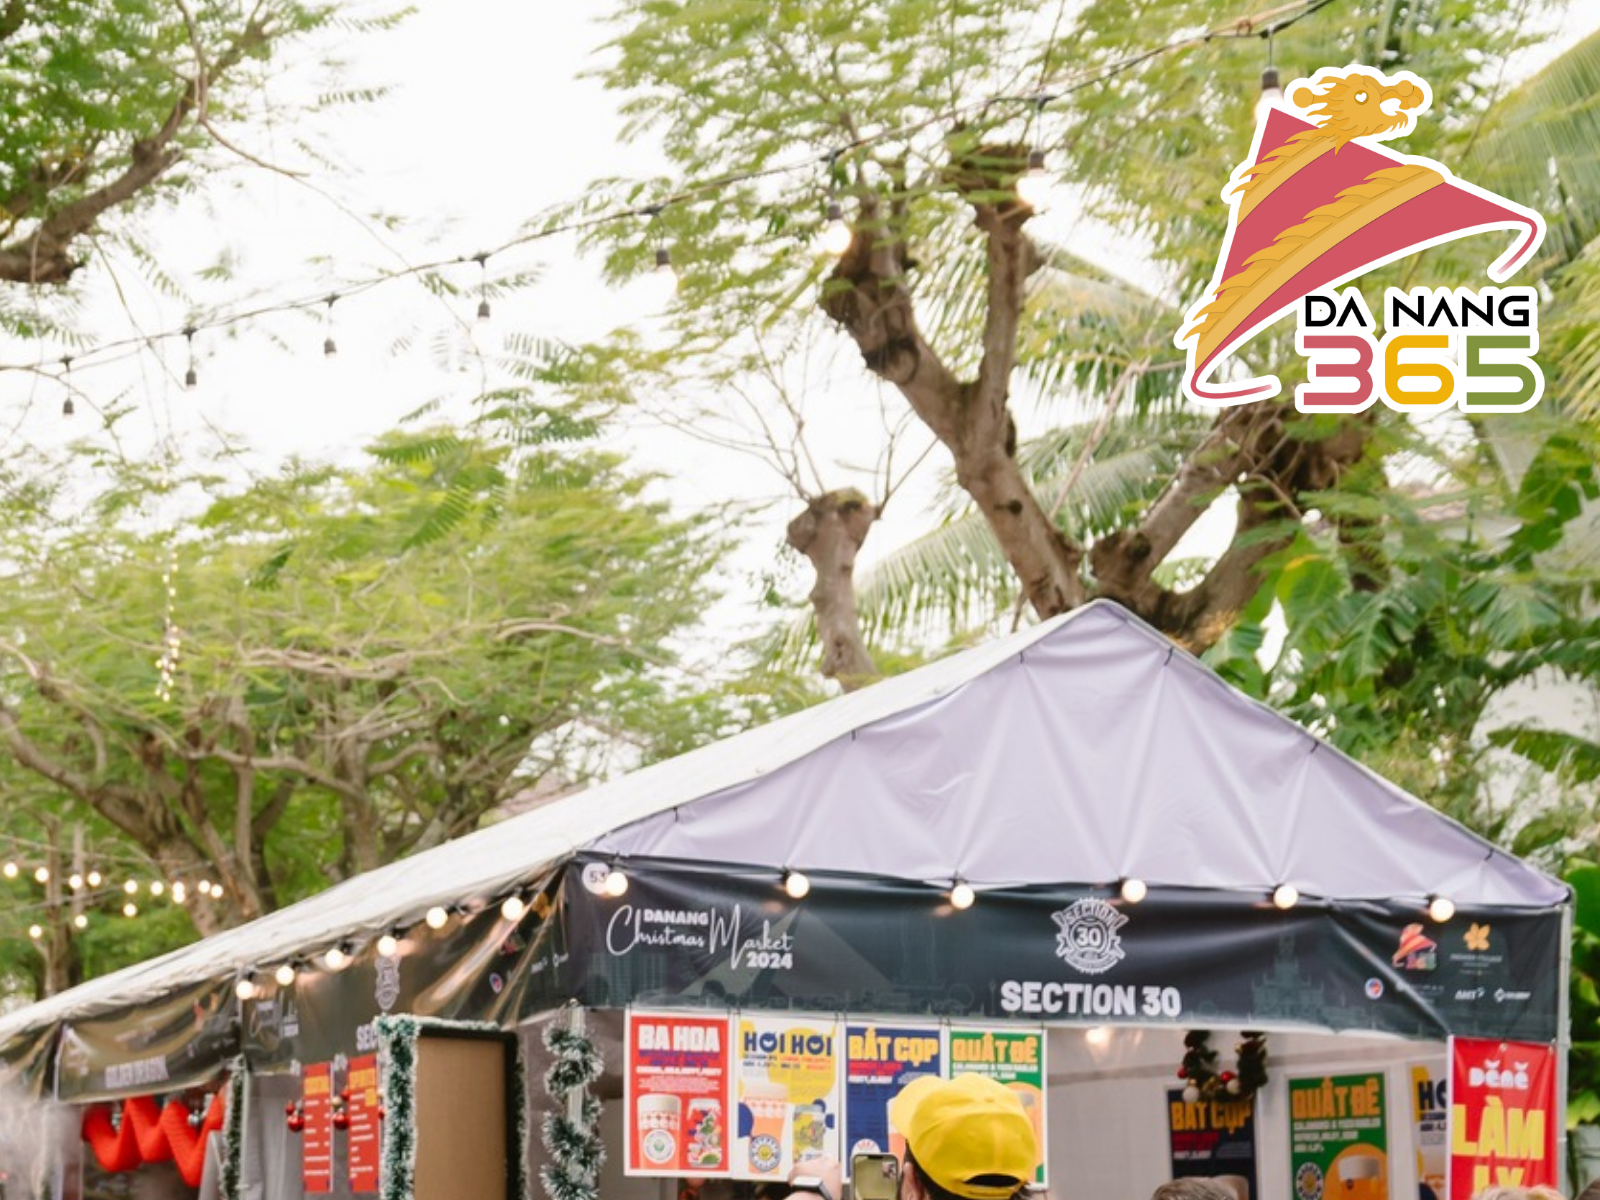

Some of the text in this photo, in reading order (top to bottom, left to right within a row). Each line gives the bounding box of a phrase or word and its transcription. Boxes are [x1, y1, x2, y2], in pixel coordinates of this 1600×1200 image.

[643, 908, 710, 926] DANANG
[1064, 902, 1118, 928] SECTION
[606, 903, 794, 970] Christmas Market
[1075, 926, 1102, 947] 30
[746, 951, 794, 970] 2024
[1000, 979, 1183, 1018] SECTION 30
[637, 1024, 672, 1051] BA
